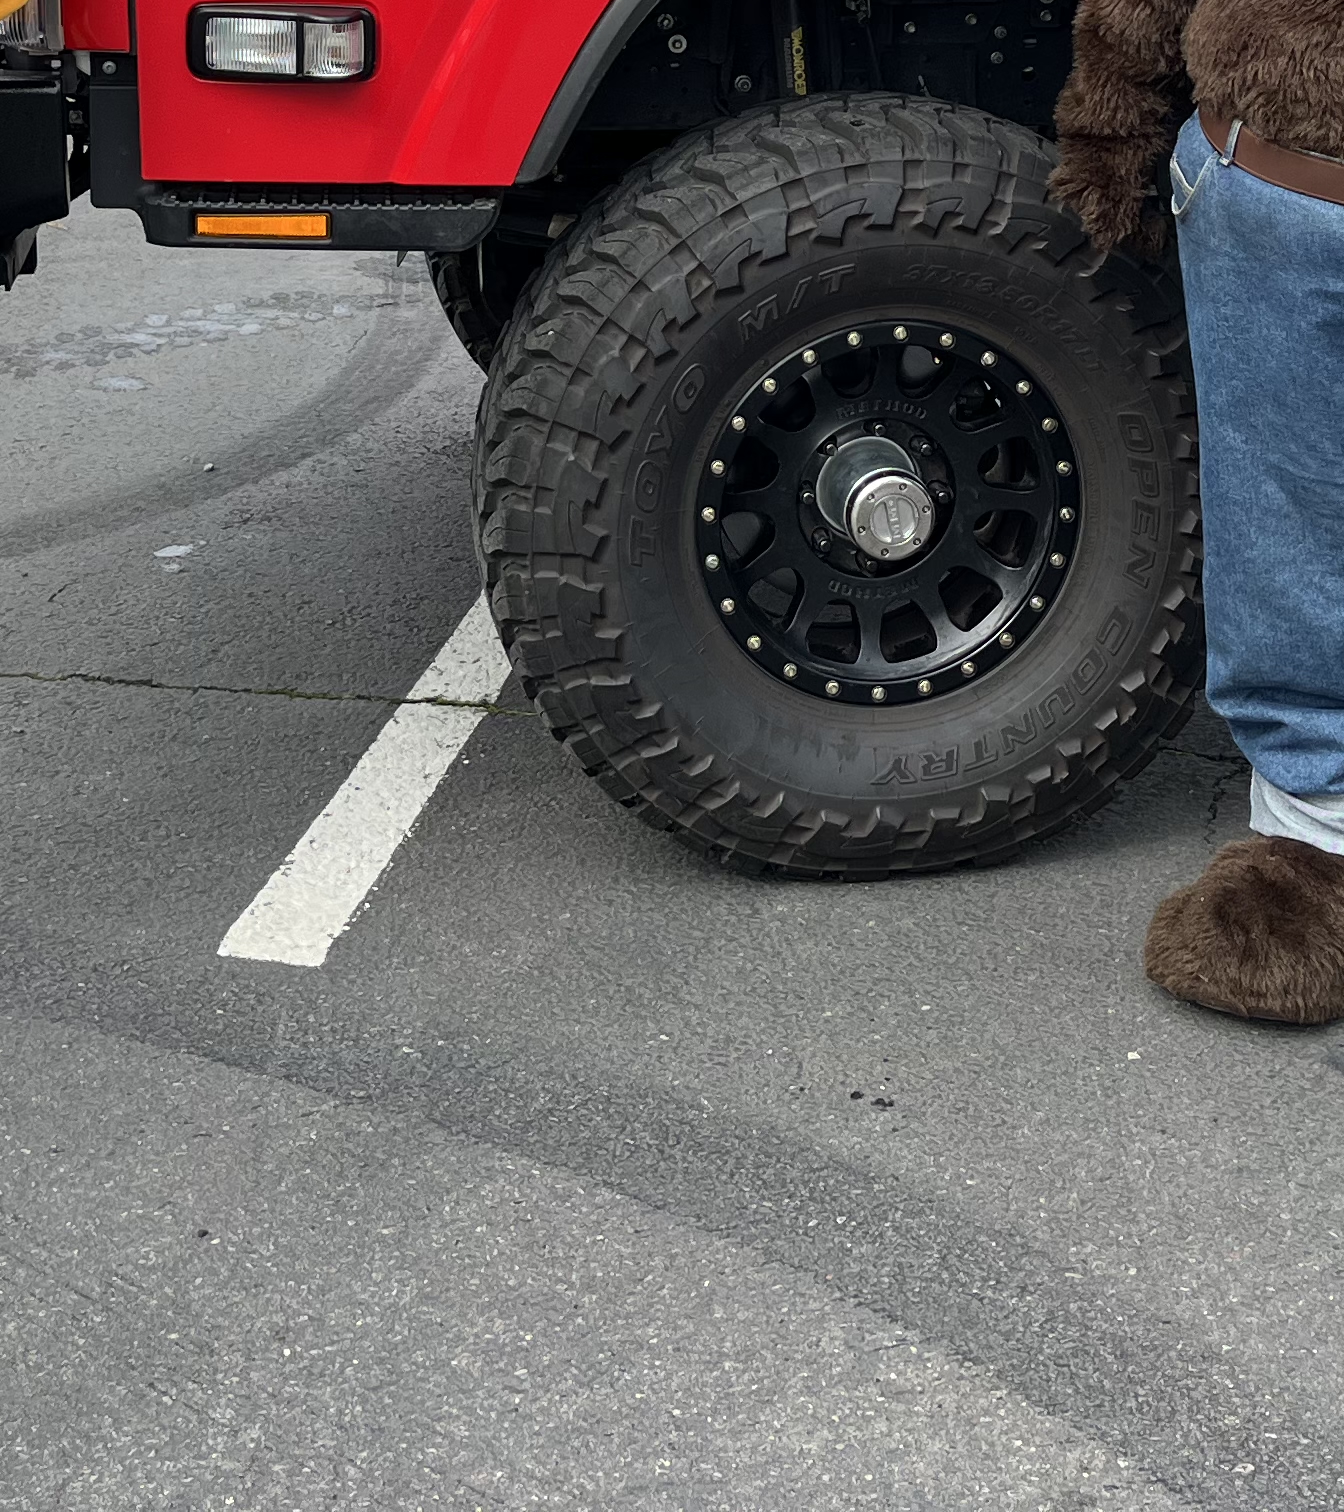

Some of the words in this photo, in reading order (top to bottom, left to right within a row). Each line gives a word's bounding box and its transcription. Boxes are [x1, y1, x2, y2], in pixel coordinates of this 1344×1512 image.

[629, 363, 706, 566] TOYO
[738, 264, 856, 341] M/T
[1117, 412, 1161, 589] OPEN
[870, 607, 1134, 785] COUNTRY
